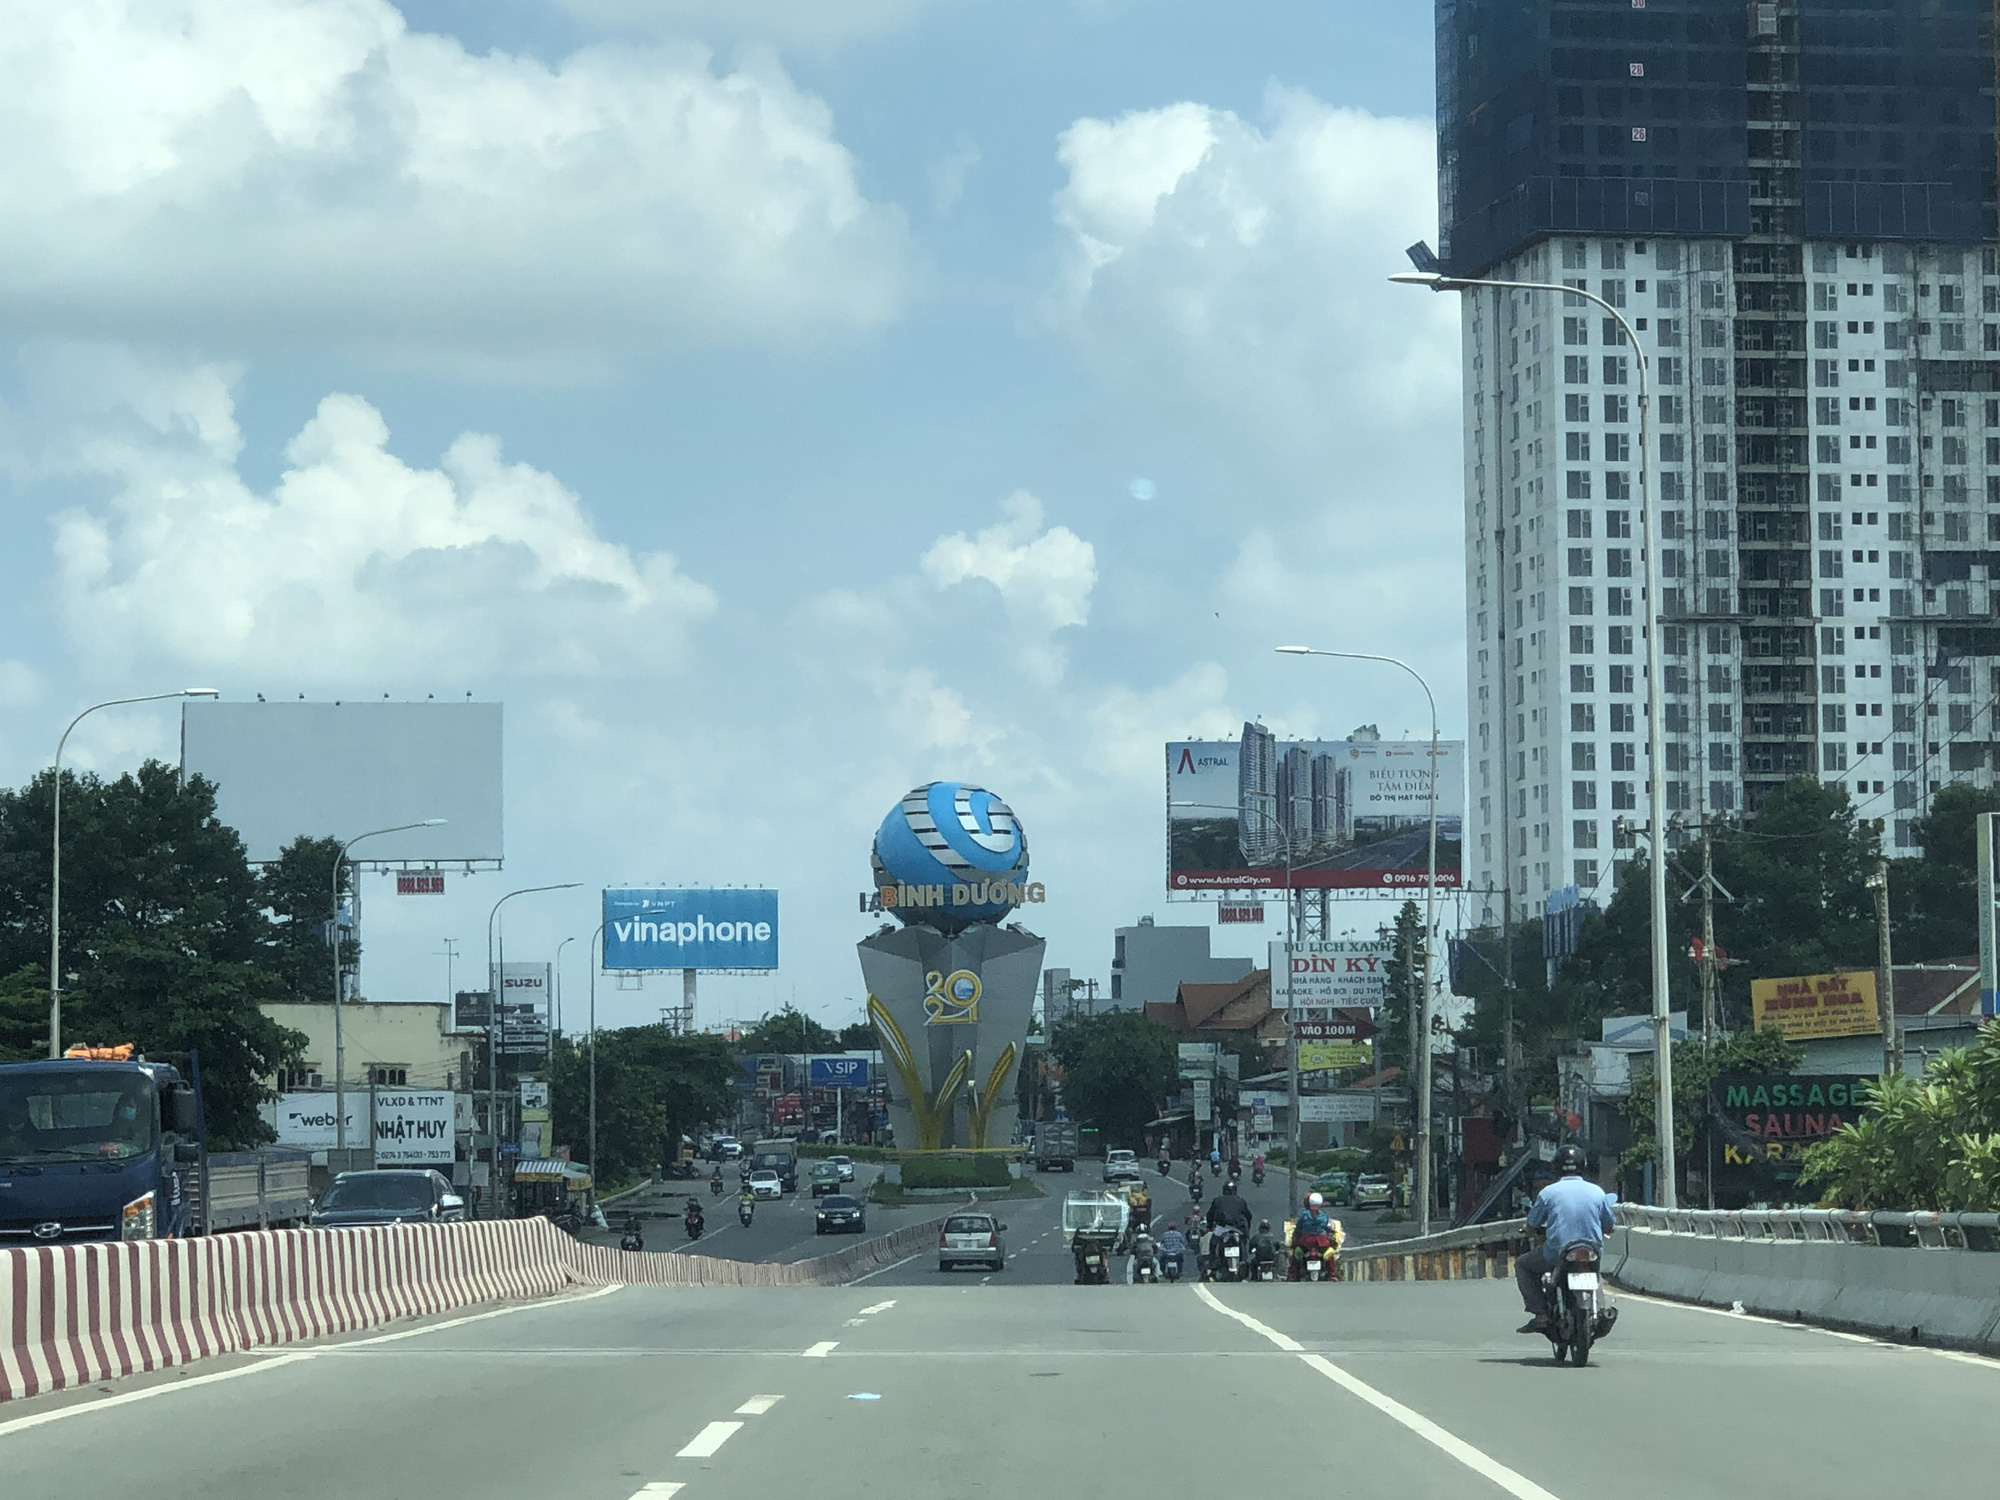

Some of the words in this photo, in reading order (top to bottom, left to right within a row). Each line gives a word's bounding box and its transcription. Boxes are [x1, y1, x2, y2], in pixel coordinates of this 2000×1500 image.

[1631, 64, 1643, 75] 28
[1633, 128, 1645, 140] 26
[1197, 757, 1229, 767] ASTRAL
[1189, 875, 1271, 886] www.AstralCity.vn
[1394, 874, 1416, 883] 0916
[881, 879, 944, 908] BÌNH
[952, 878, 1046, 906] DƯƠNG
[651, 900, 676, 908] VNPT
[613, 914, 772, 947] vinaphone
[1284, 942, 1304, 953] DU
[1309, 942, 1344, 954] LỊCH
[1349, 942, 1391, 952] XANH
[1292, 953, 1336, 973] DÌN
[1345, 953, 1381, 973] KÝ
[504, 978, 543, 988] SUZU
[1275, 988, 1313, 996] KAAOKE
[378, 1096, 406, 1107] VLXD
[408, 1096, 415, 1106] &
[417, 1096, 444, 1106] TTNT
[1726, 1083, 1866, 1108] MASSAGE
[301, 1112, 353, 1126] webr
[1745, 1113, 1844, 1136] SAUNA
[376, 1114, 415, 1144] NHẬT
[417, 1120, 447, 1139] HUY
